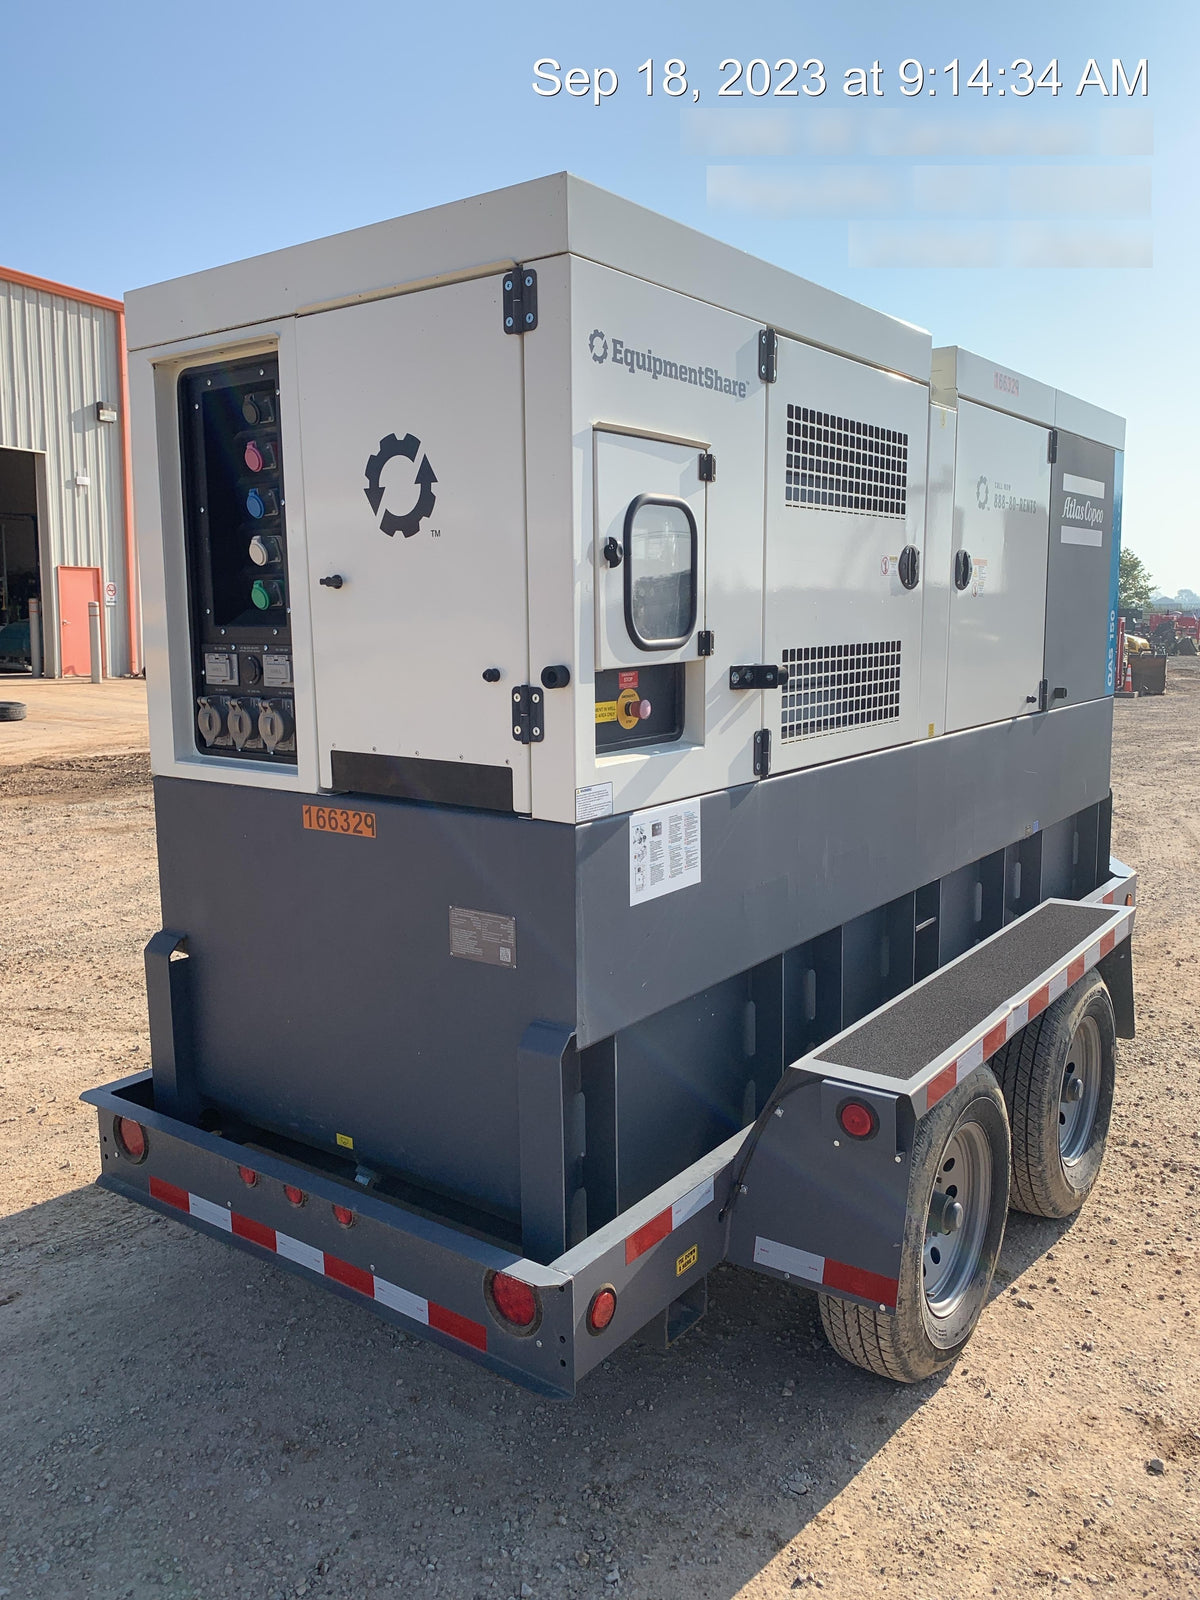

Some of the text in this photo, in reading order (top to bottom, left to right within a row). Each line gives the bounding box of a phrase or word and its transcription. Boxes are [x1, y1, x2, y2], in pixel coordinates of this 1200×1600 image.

[611, 338, 746, 399] EquipmentShare
[1061, 496, 1104, 527] Atlas Copco
[430, 529, 441, 538] TM
[303, 806, 376, 837] 166329
